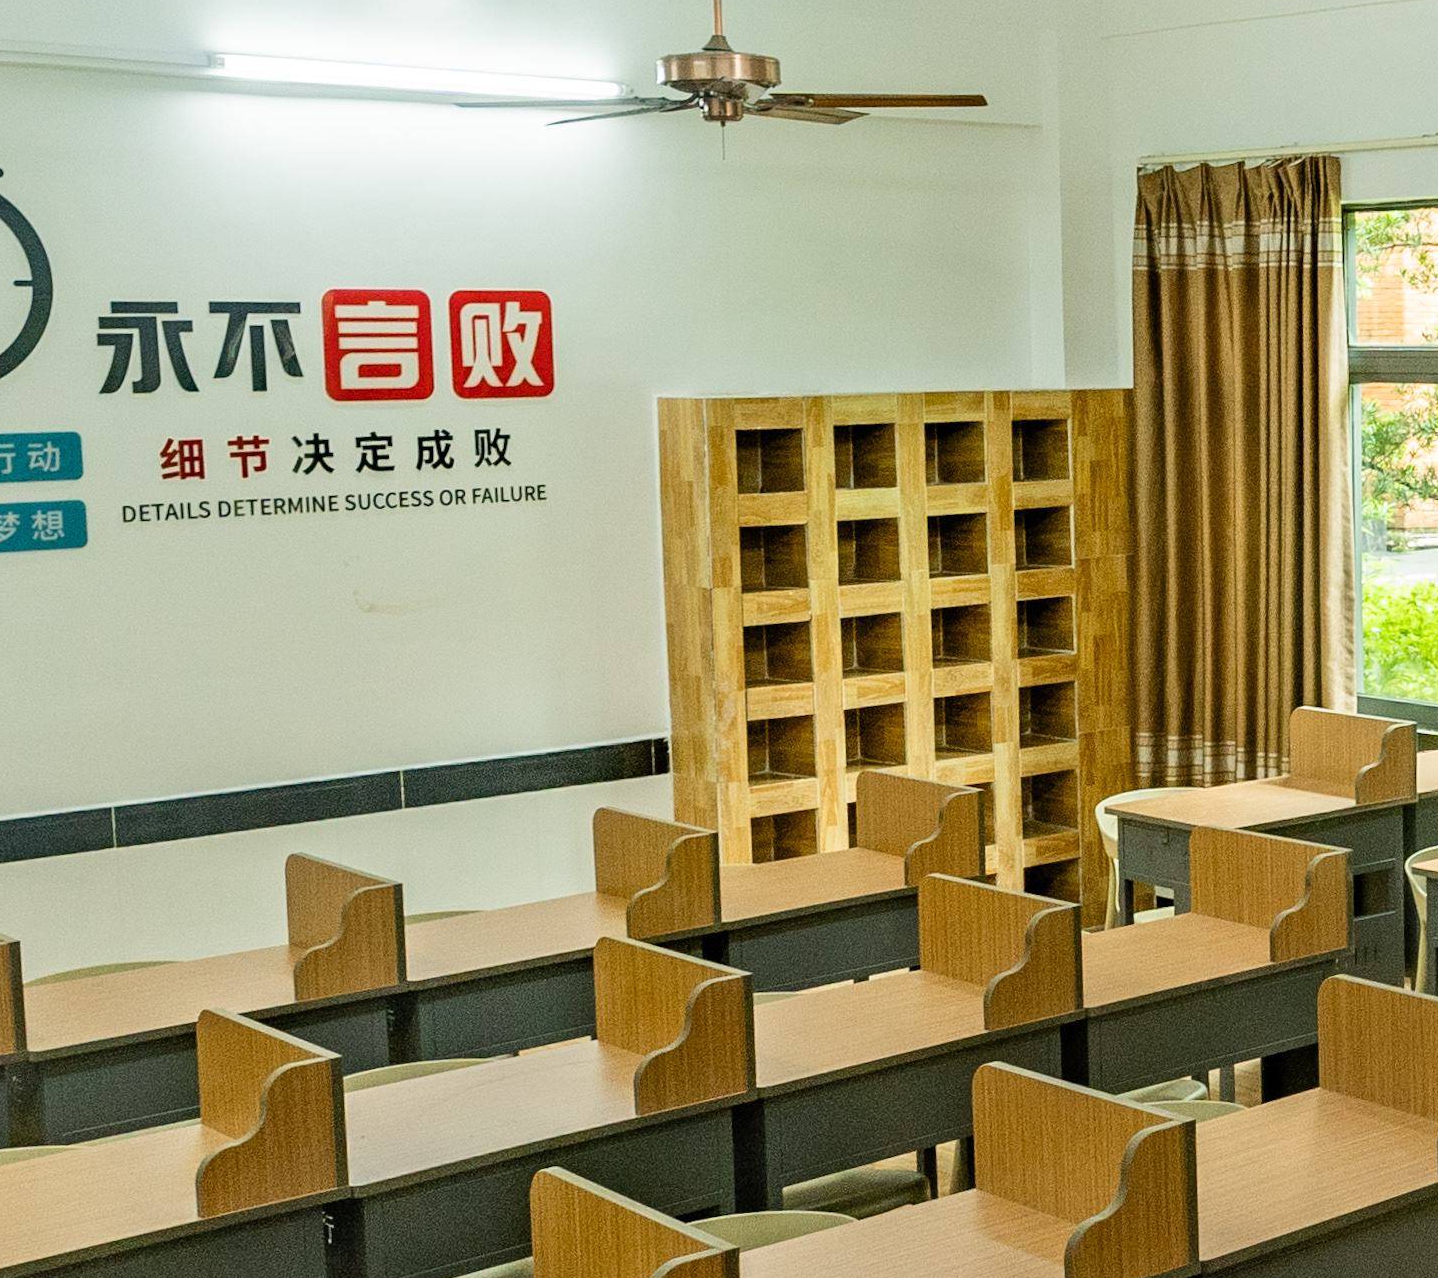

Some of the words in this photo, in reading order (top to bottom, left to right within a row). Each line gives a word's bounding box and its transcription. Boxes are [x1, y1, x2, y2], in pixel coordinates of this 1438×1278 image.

[95, 299, 546, 395] 永不言败
[160, 428, 513, 481] 细节决定成败
[121, 500, 212, 524] DETAILS
[217, 494, 340, 519] DETERMINE
[344, 489, 435, 512] SUCCESS
[438, 488, 467, 507] OR
[471, 483, 548, 505] FAILURE
